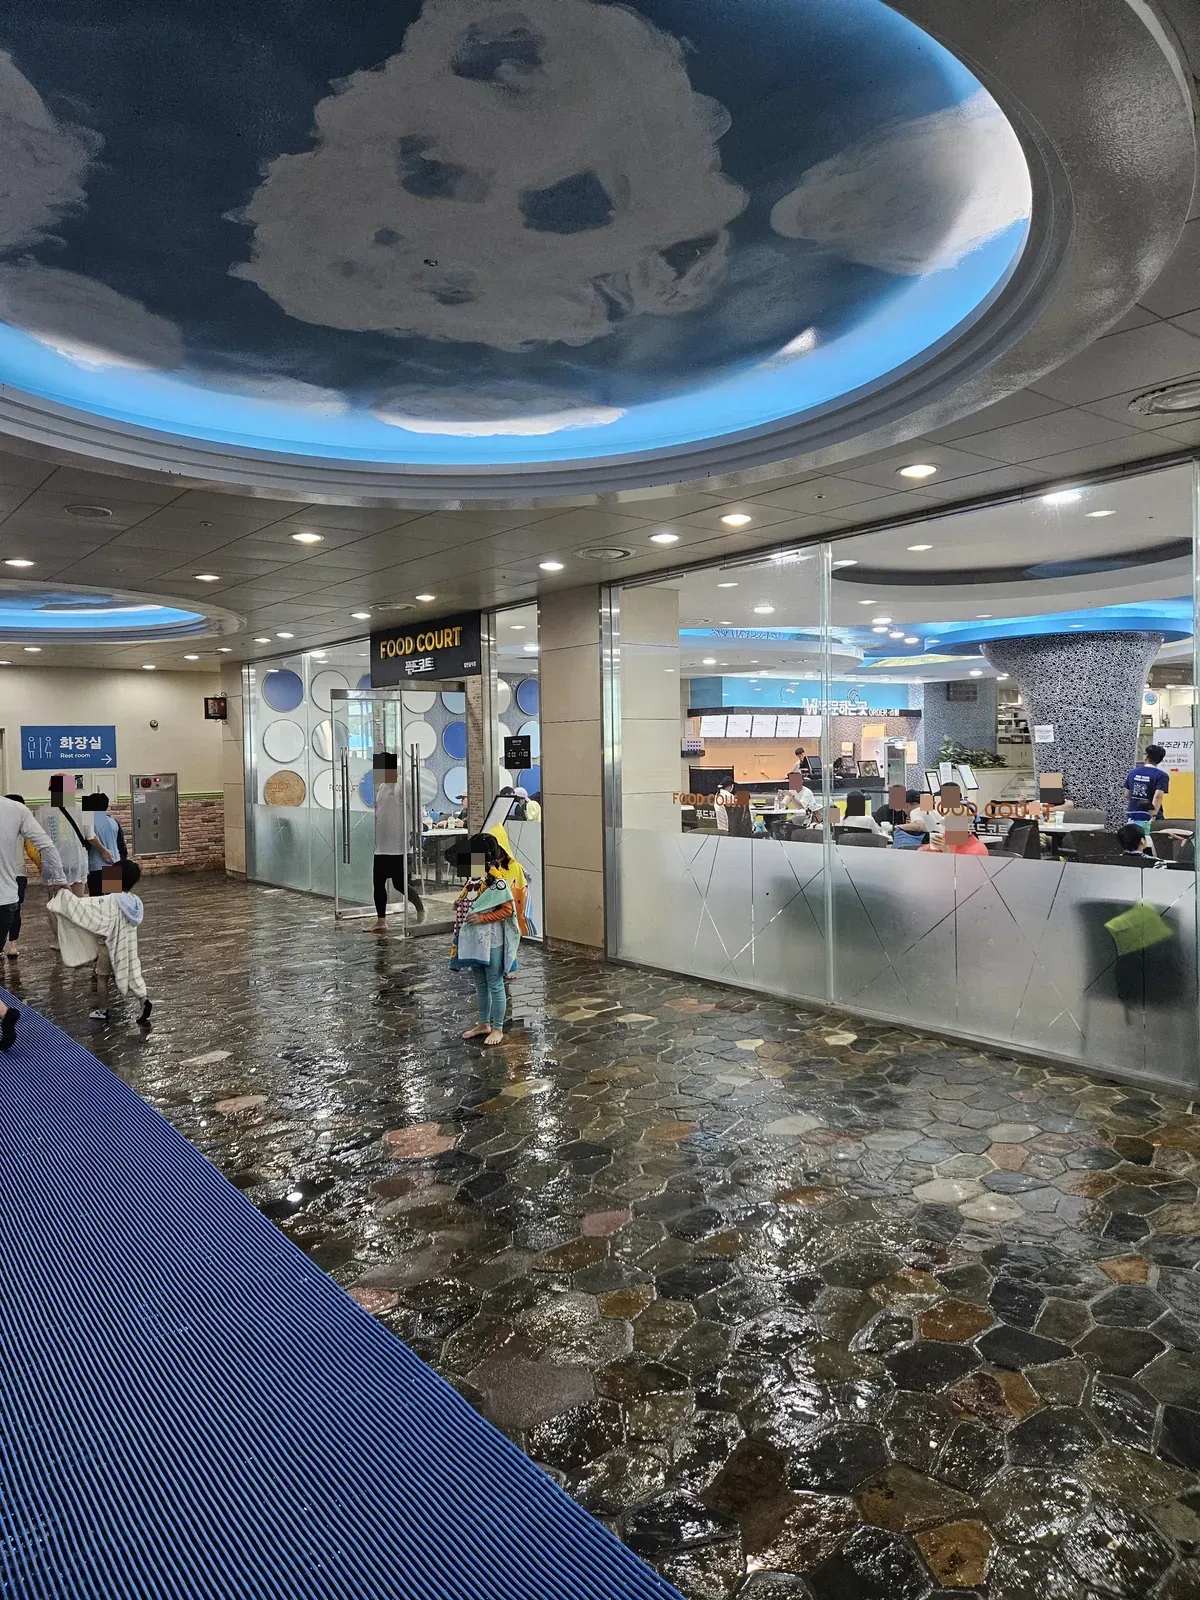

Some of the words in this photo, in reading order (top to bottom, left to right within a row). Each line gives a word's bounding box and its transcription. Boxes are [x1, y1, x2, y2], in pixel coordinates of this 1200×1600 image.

[380, 636, 415, 659] FOOD
[416, 626, 462, 652] COURT
[59, 736, 102, 750] 화장실
[672, 792, 704, 806] FOOD
[707, 793, 745, 808] COU
[985, 801, 1055, 820] COUT
